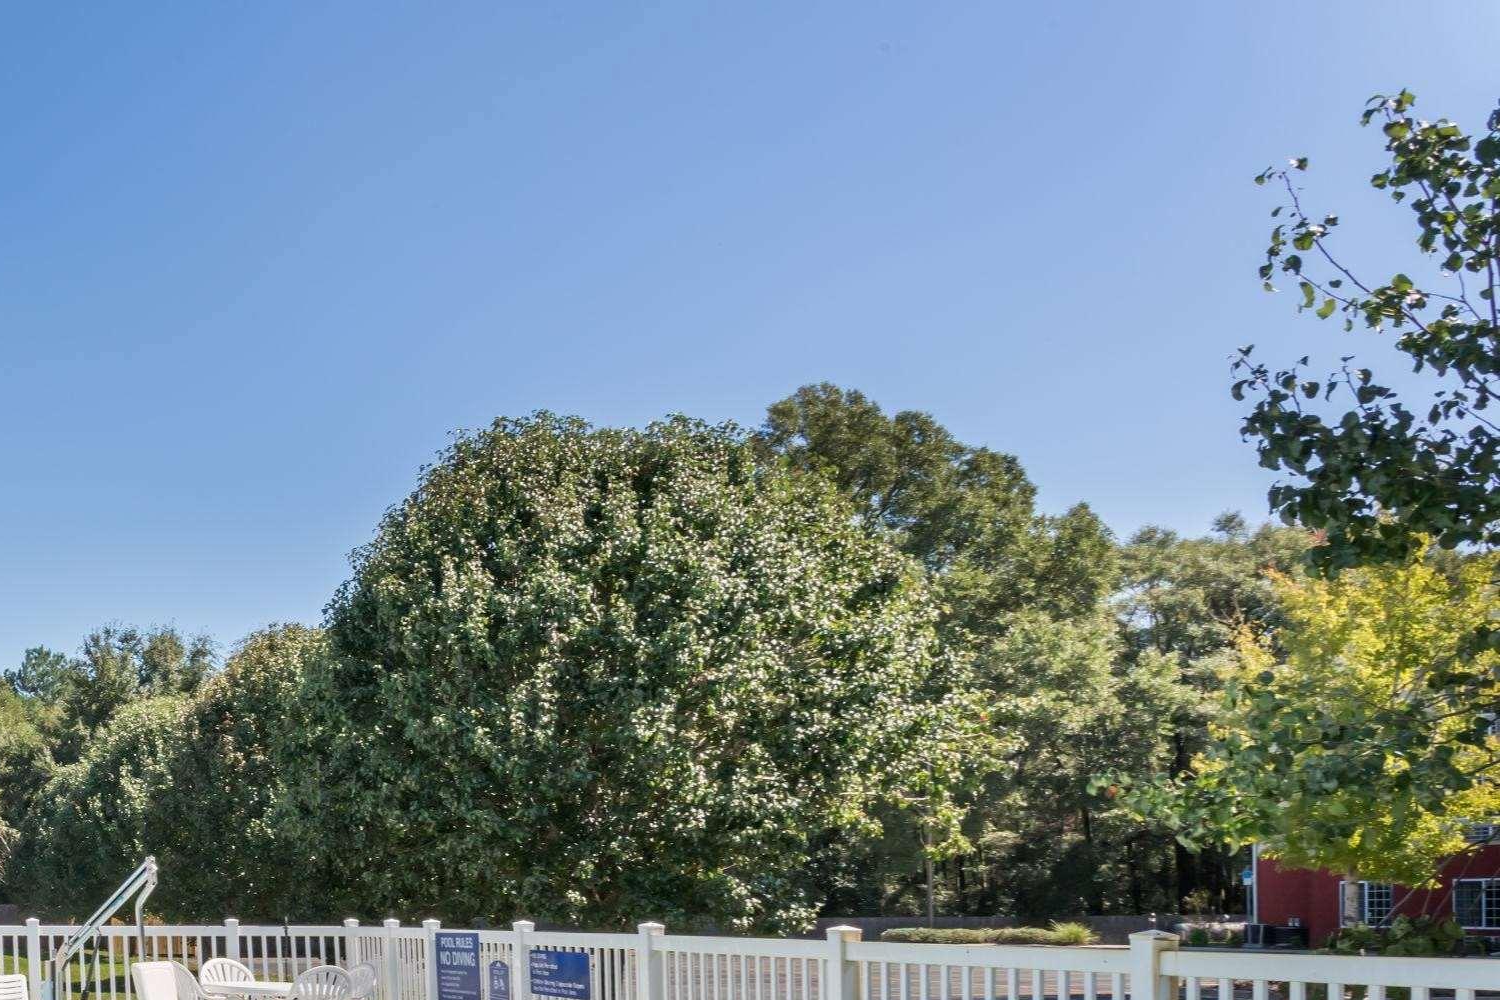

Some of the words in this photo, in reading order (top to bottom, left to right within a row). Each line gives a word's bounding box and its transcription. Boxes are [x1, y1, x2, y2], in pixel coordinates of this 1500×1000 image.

[440, 937, 455, 948] POOL
[455, 937, 473, 949] RULES
[440, 951, 451, 965] NO
[452, 951, 476, 967] DIVING
